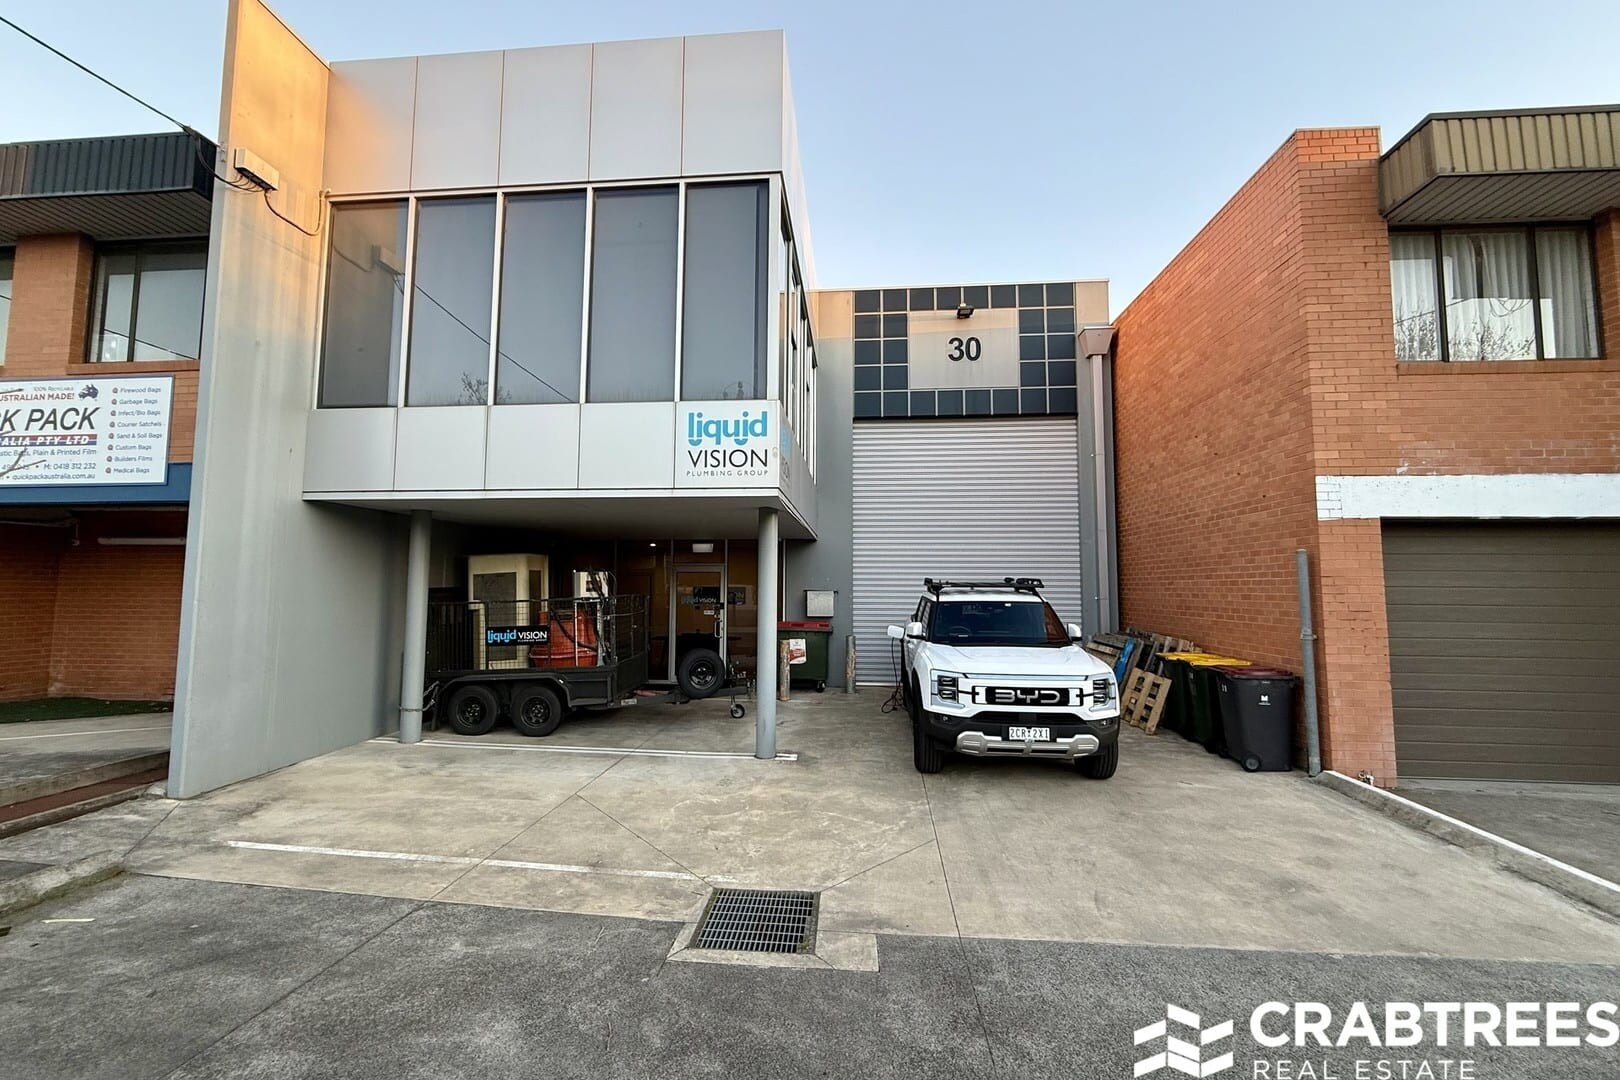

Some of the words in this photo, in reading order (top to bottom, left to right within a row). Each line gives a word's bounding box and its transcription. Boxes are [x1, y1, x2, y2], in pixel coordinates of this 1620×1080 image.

[948, 336, 981, 361] 30
[48, 392, 75, 400] MADE!
[0, 409, 22, 431] K
[25, 407, 100, 431] PACK
[688, 411, 768, 446] liquid
[0, 436, 30, 446] ALIA
[37, 435, 64, 445] PTY
[66, 435, 91, 445] LTD
[33, 448, 49, 456] Plain
[50, 448, 56, 456] &
[57, 447, 81, 456] Printed
[82, 447, 97, 455] Film
[688, 449, 768, 468] VISION
[487, 629, 517, 643] liquid
[518, 630, 548, 640] VISION
[995, 689, 1060, 704] BYD
